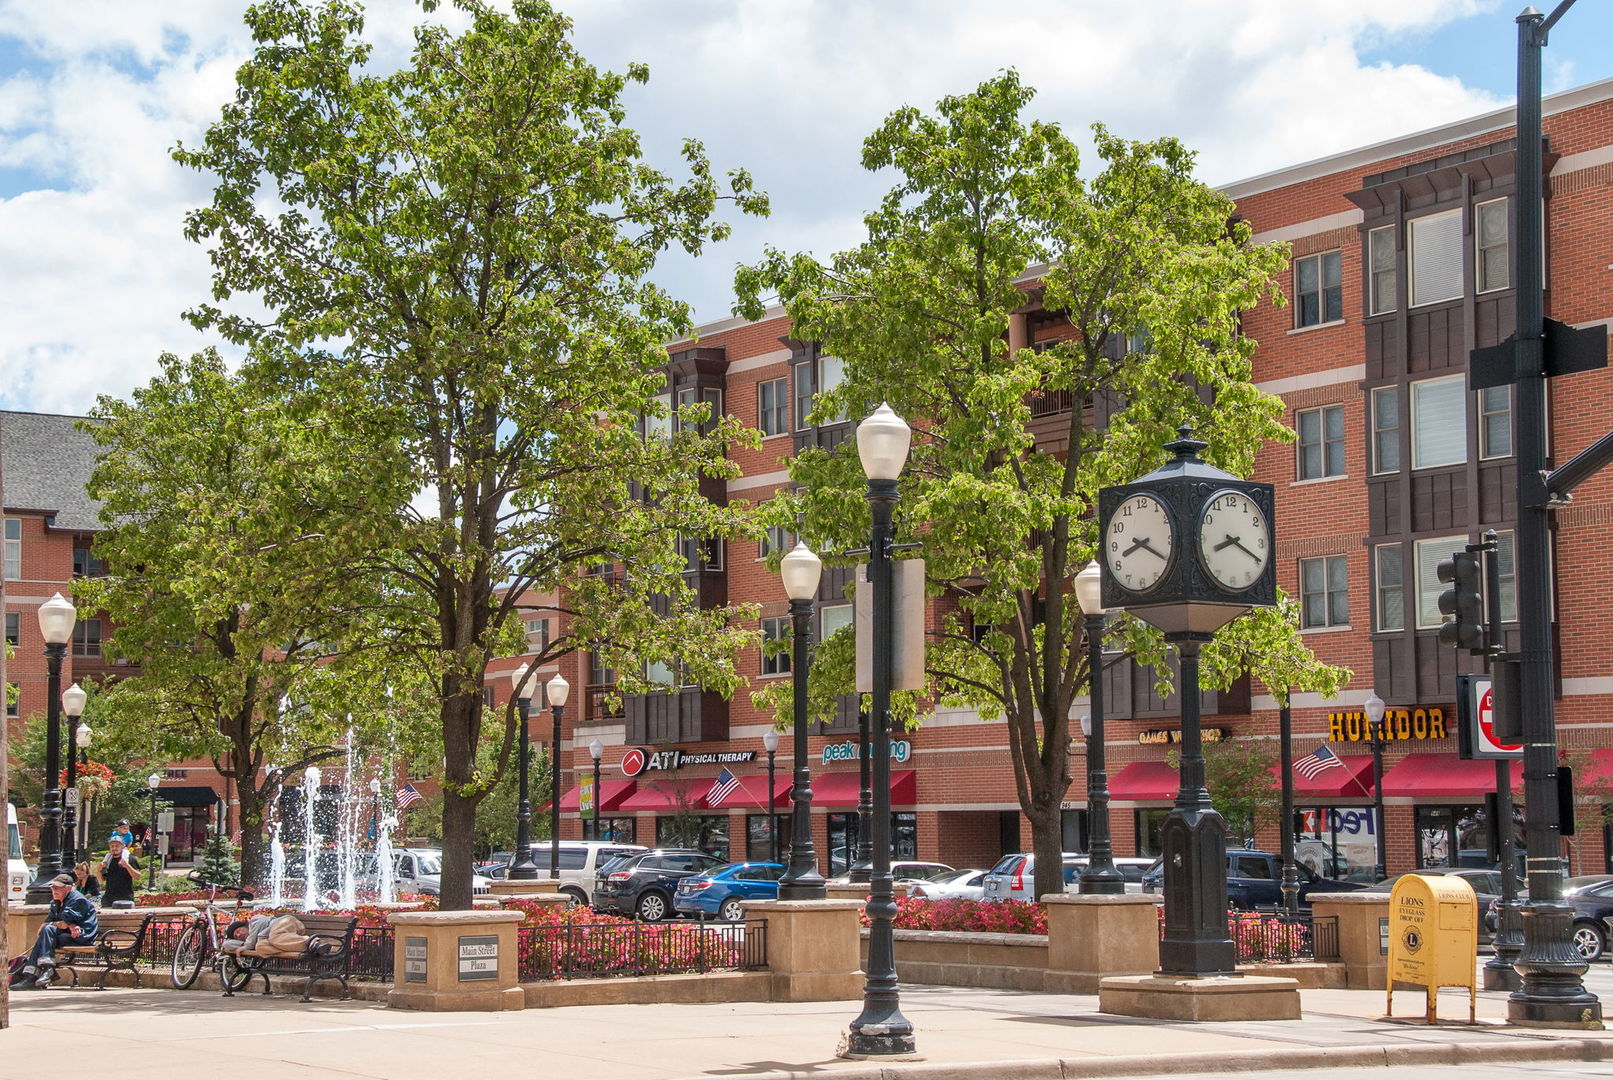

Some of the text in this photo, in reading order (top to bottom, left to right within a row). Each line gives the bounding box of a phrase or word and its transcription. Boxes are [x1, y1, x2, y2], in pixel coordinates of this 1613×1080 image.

[1136, 498, 1148, 509] 12
[1154, 503, 1159, 512] 1
[1212, 501, 1221, 511] 11
[1225, 497, 1237, 507] 12
[1123, 505, 1132, 516] 11
[1243, 503, 1248, 513] 1
[1252, 516, 1259, 527] 2
[1113, 522, 1124, 533] 10
[1111, 541, 1118, 552] 9
[1257, 538, 1264, 549] 3
[1115, 560, 1122, 571] 8
[1125, 574, 1132, 585] 7
[1139, 577, 1146, 589] 6
[1229, 576, 1236, 585] 6
[1139, 730, 1169, 744] GAMES
[822, 740, 856, 765] peak
[646, 751, 753, 770] ATI PHYSICAL THERAPY
[1400, 896, 1424, 907] LIONS
[1399, 907, 1426, 916] EYEGLASS
[1414, 915, 1424, 923] OFF
[461, 946, 477, 955] Main
[478, 945, 496, 955] Street
[470, 960, 487, 970] Plaza
